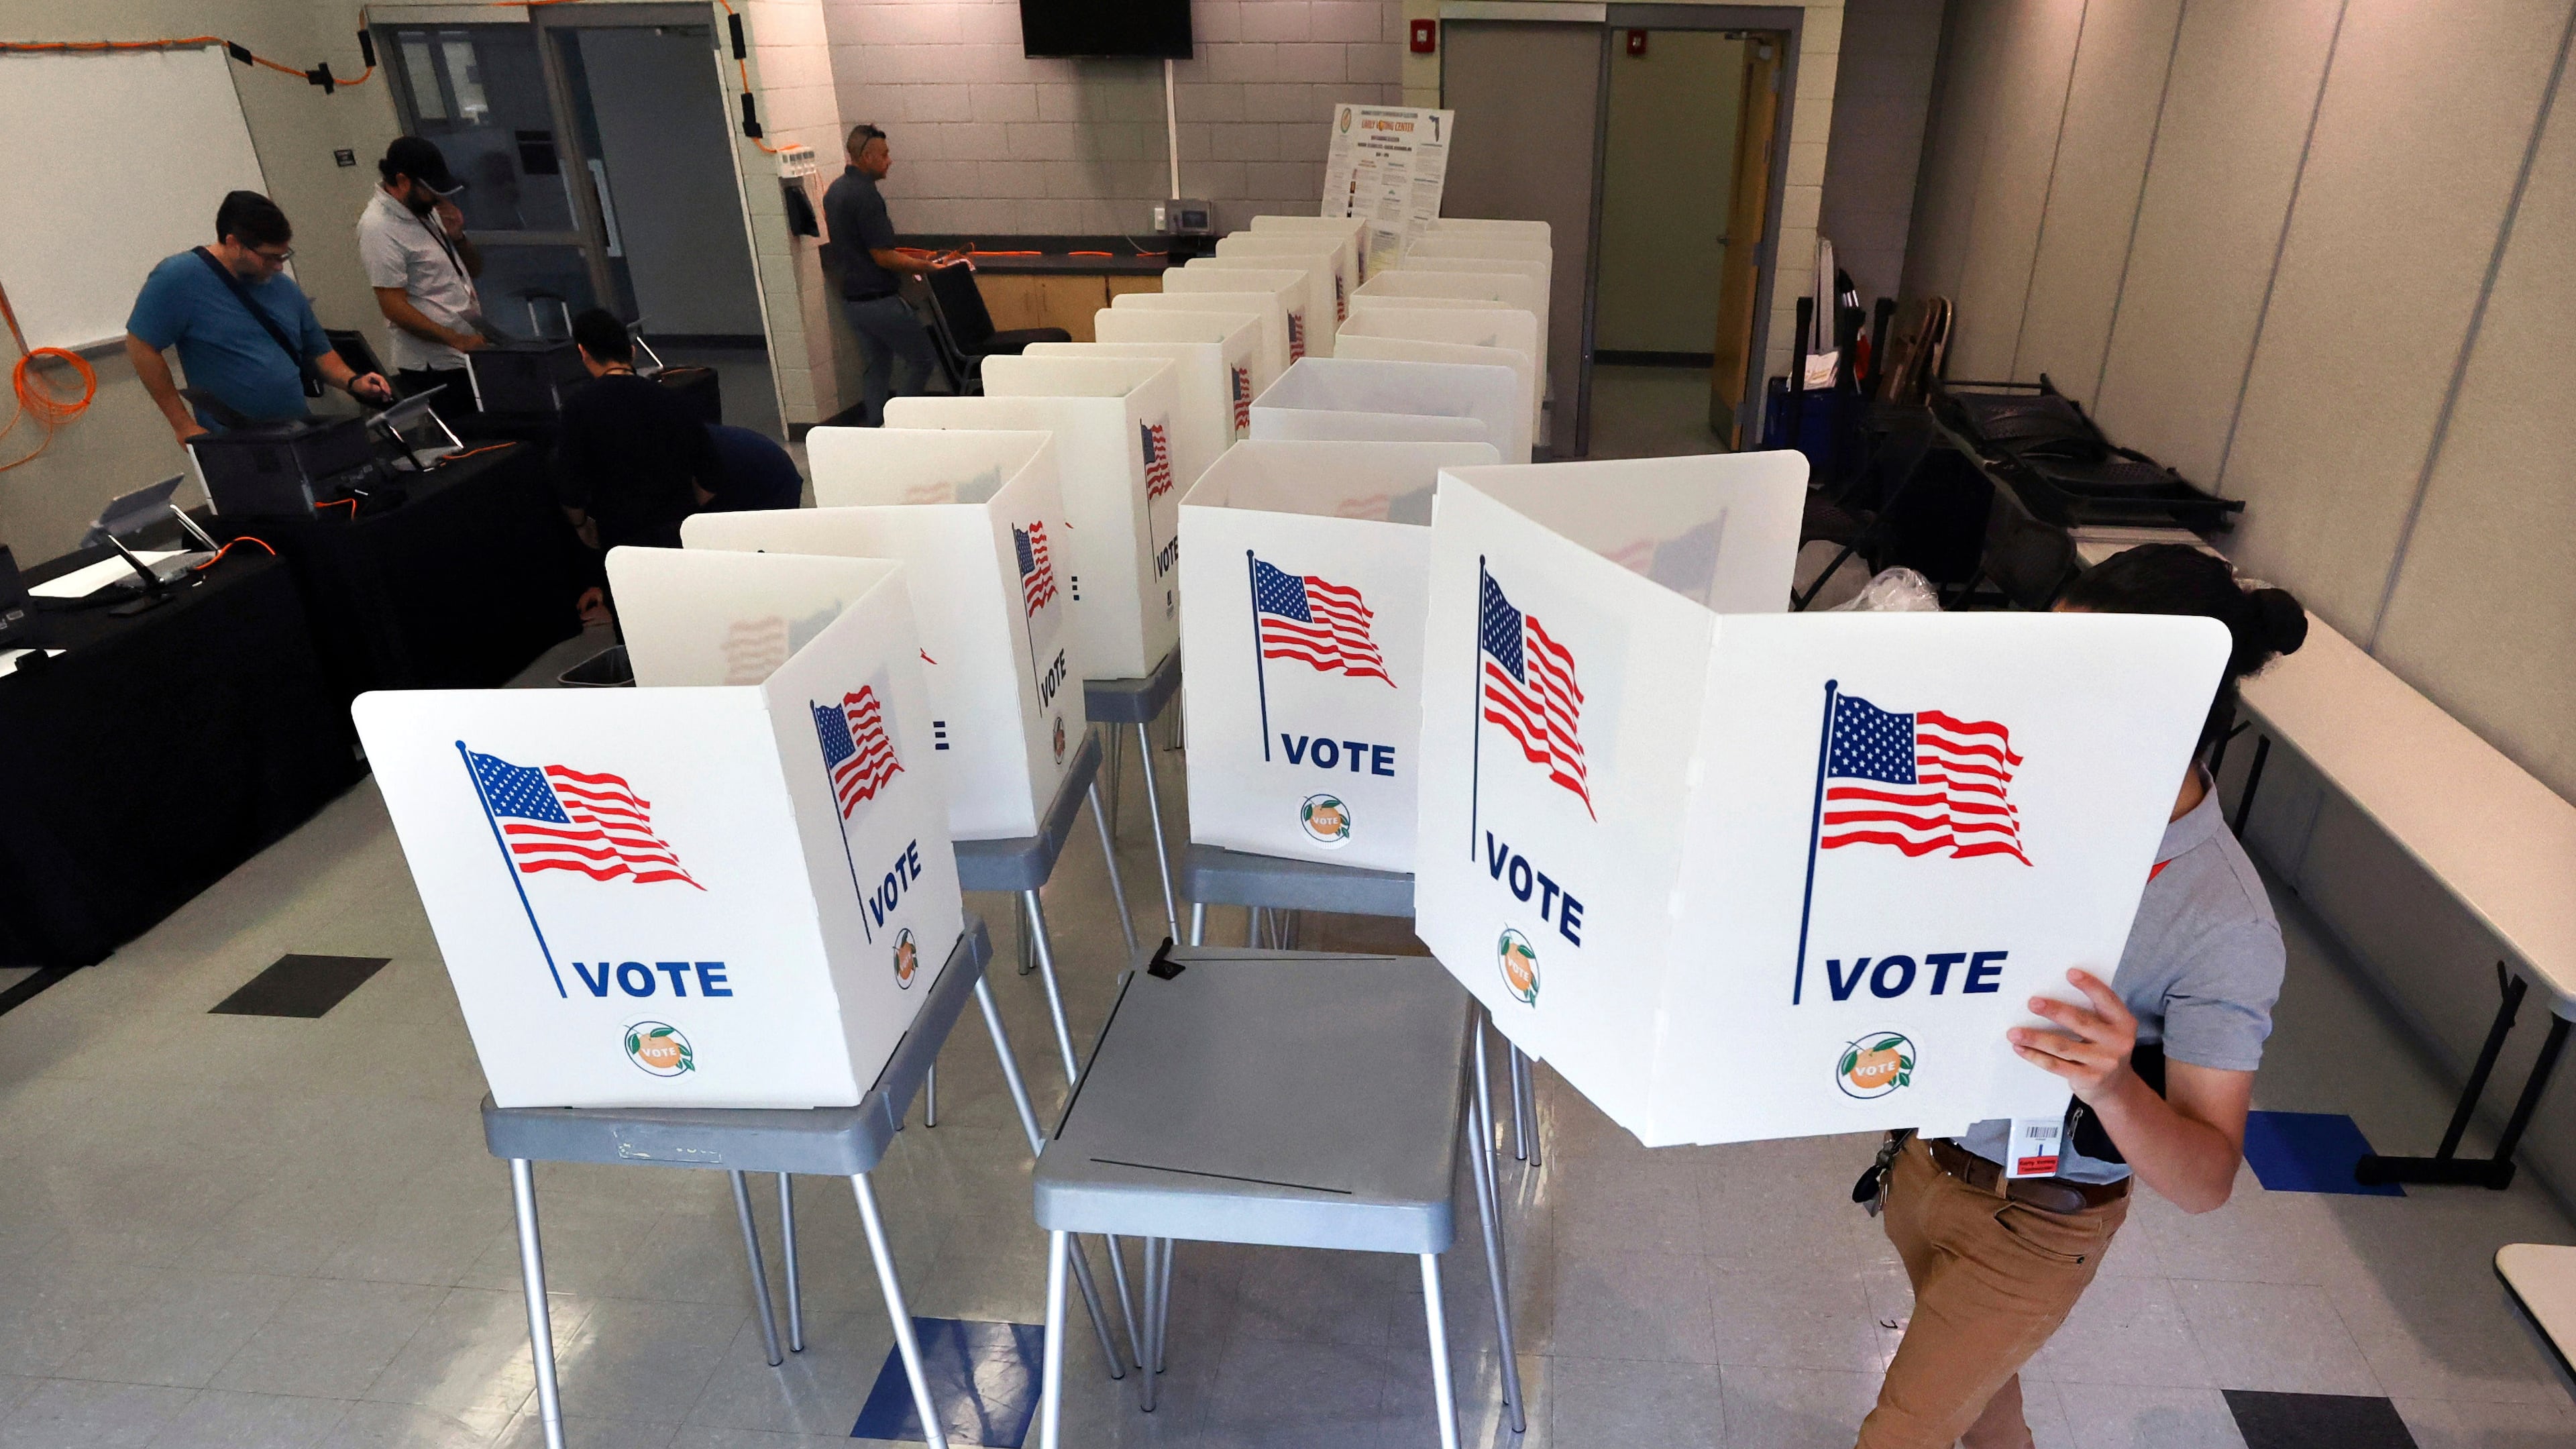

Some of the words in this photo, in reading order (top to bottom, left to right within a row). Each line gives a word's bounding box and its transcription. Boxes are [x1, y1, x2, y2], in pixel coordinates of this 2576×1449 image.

[1157, 535, 1179, 578] VOTE
[1041, 647, 1067, 708] VOTE
[1281, 733, 1395, 777] VOTE
[1312, 816, 1339, 825] VOTE
[869, 839, 921, 928] VOTE
[1486, 830, 1584, 948] VOTE
[572, 961, 733, 998] VOTE
[1508, 958, 1530, 981] VOTE
[1826, 951, 2008, 1002] VOTE
[641, 1046, 677, 1058] VOTE
[1854, 1061, 1896, 1077] VOTE
